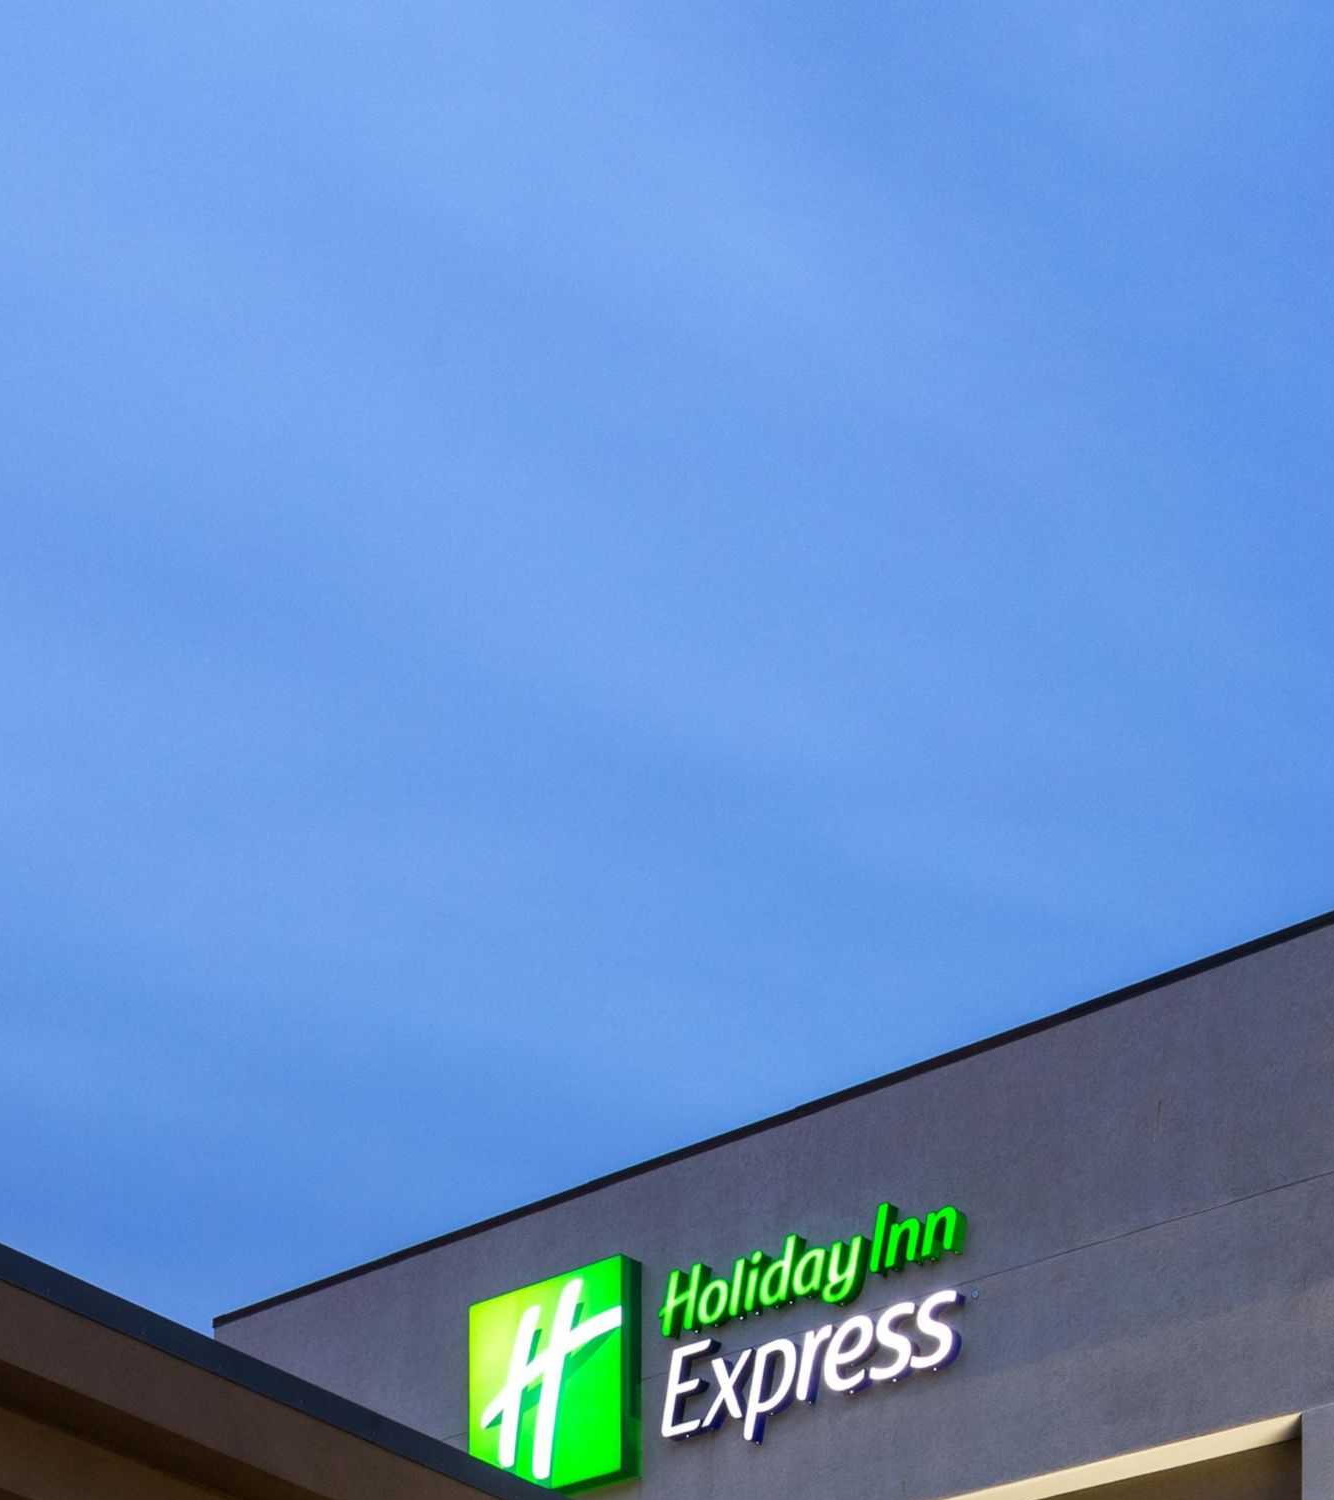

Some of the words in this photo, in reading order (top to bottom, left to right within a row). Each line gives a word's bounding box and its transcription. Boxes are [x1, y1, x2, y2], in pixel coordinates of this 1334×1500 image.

[658, 1233, 868, 1337] Holiday
[869, 1202, 964, 1273] Inn
[480, 1276, 622, 1481] H
[660, 1289, 963, 1442] Express
